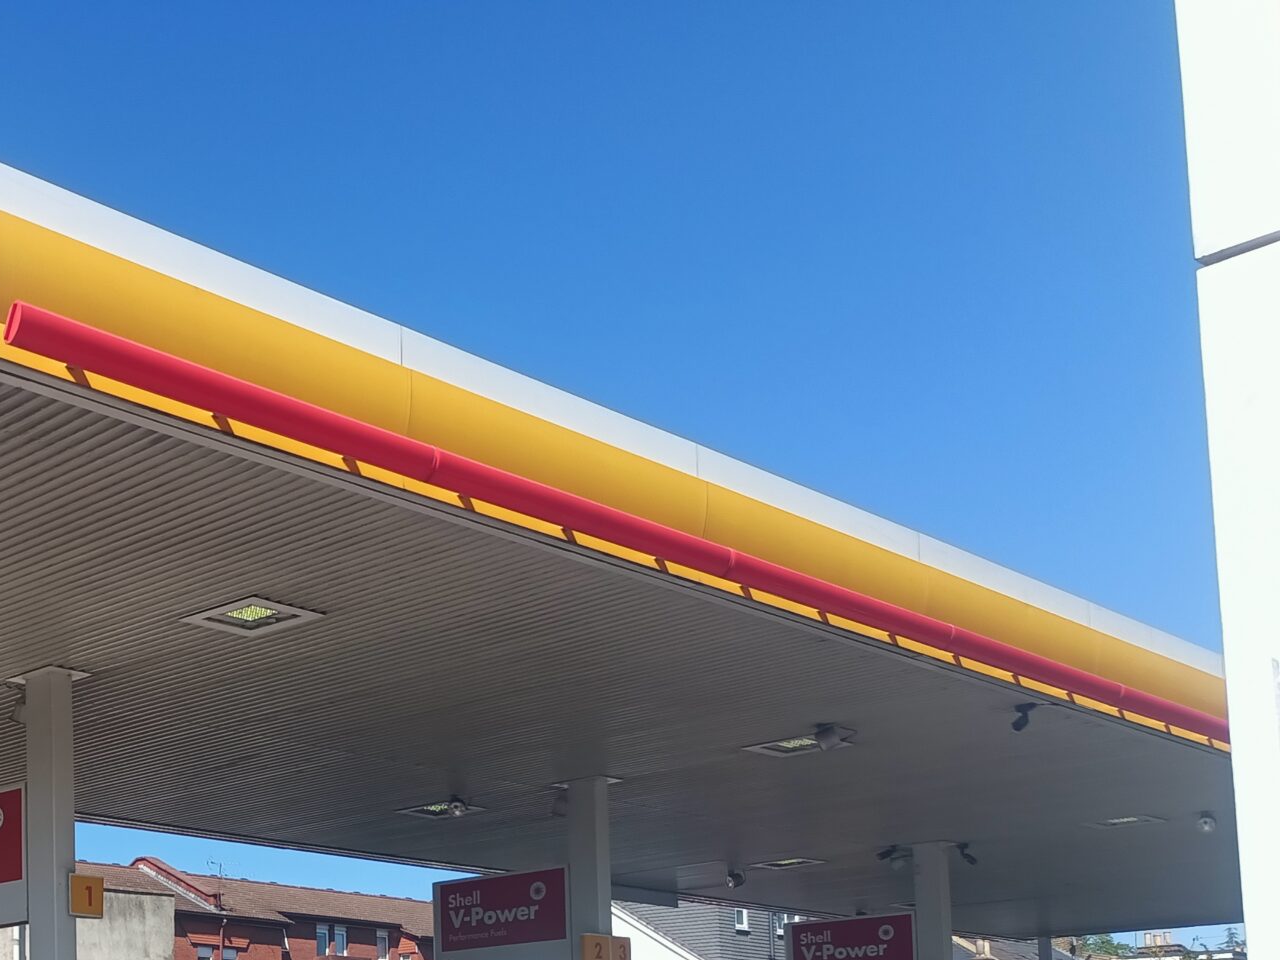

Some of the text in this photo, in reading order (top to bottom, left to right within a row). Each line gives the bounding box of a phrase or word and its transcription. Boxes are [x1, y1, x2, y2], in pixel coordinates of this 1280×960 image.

[83, 886, 93, 907] 1
[448, 890, 481, 908] Shell
[449, 903, 539, 929] V-Power
[448, 928, 507, 942] Performance Fuels
[800, 930, 831, 945] Shell
[594, 942, 603, 959] 2
[618, 944, 626, 960] 3
[801, 943, 888, 960] V-Power
